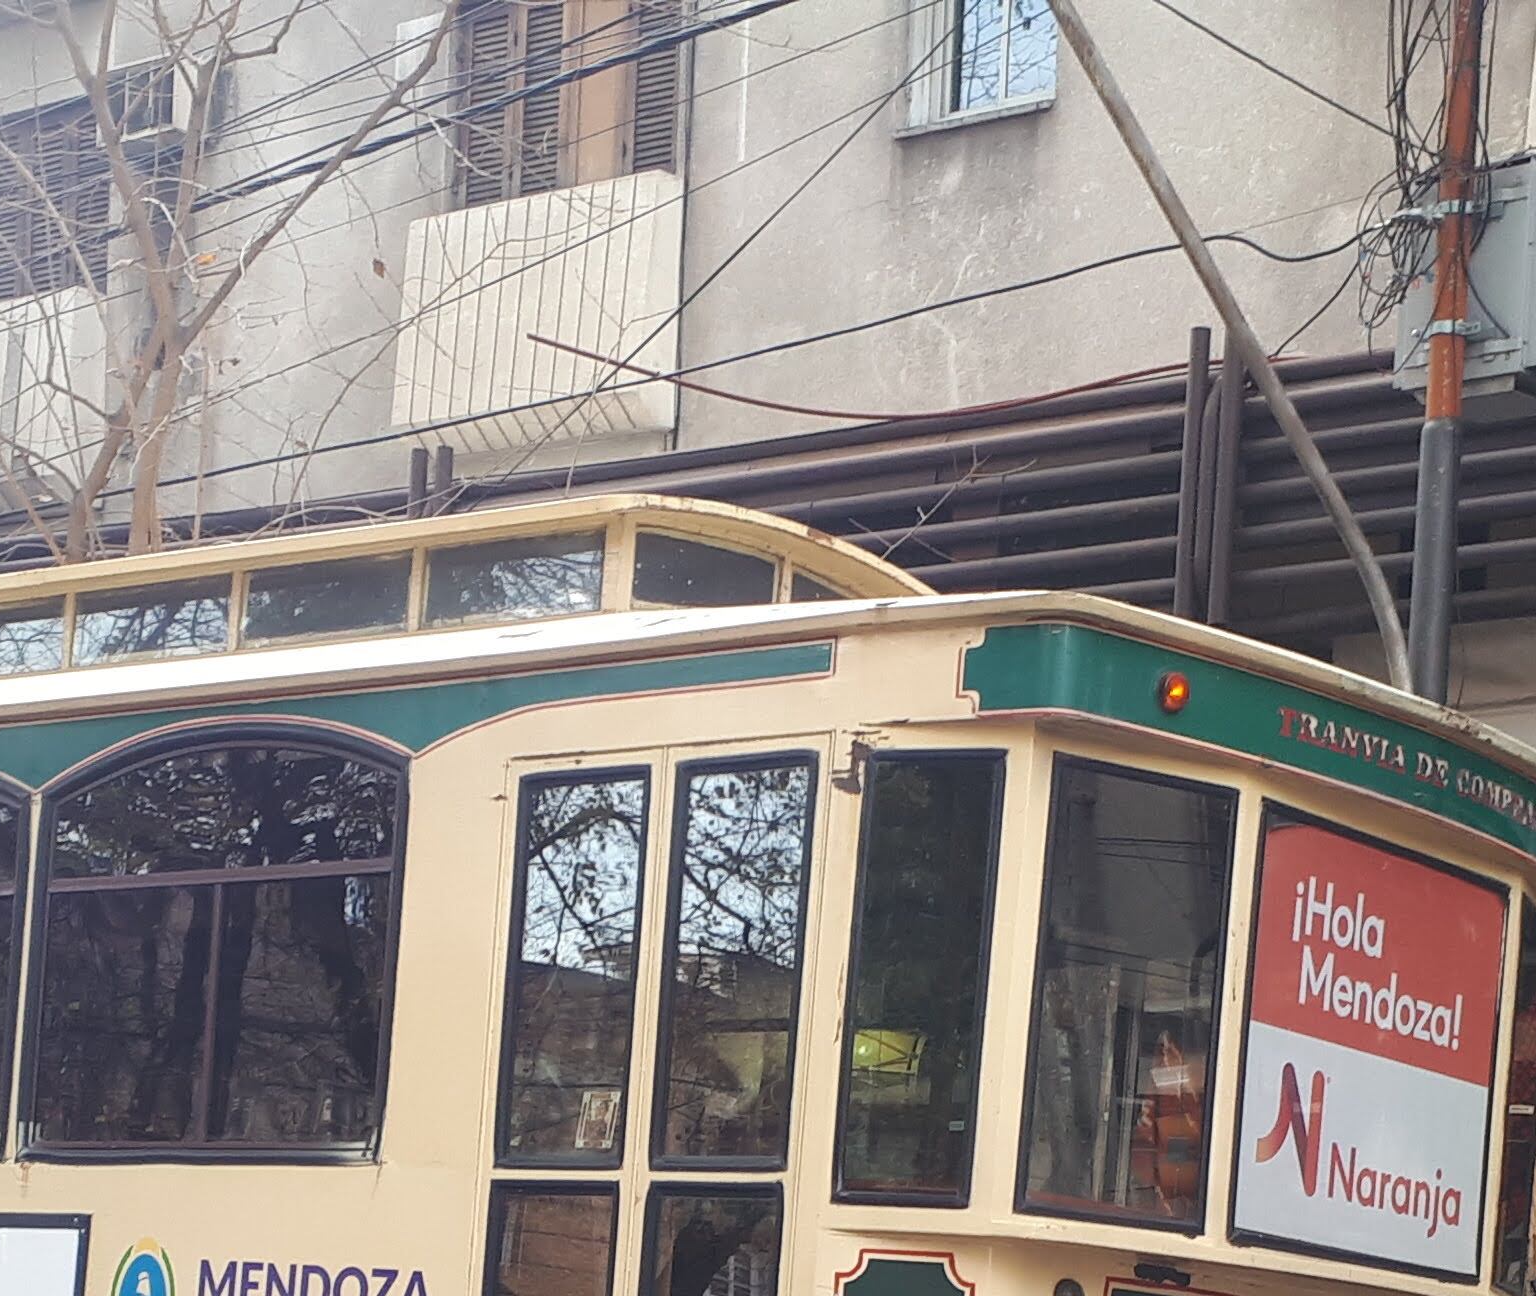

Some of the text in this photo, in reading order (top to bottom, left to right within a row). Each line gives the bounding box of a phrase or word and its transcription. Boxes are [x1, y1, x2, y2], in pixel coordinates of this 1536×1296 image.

[1279, 706, 1406, 775] TRANVIA
[1416, 752, 1449, 788] DE
[1292, 876, 1386, 959] ¡Hola
[1298, 945, 1463, 1051] Mendoza!
[1328, 1141, 1462, 1239] Naranja
